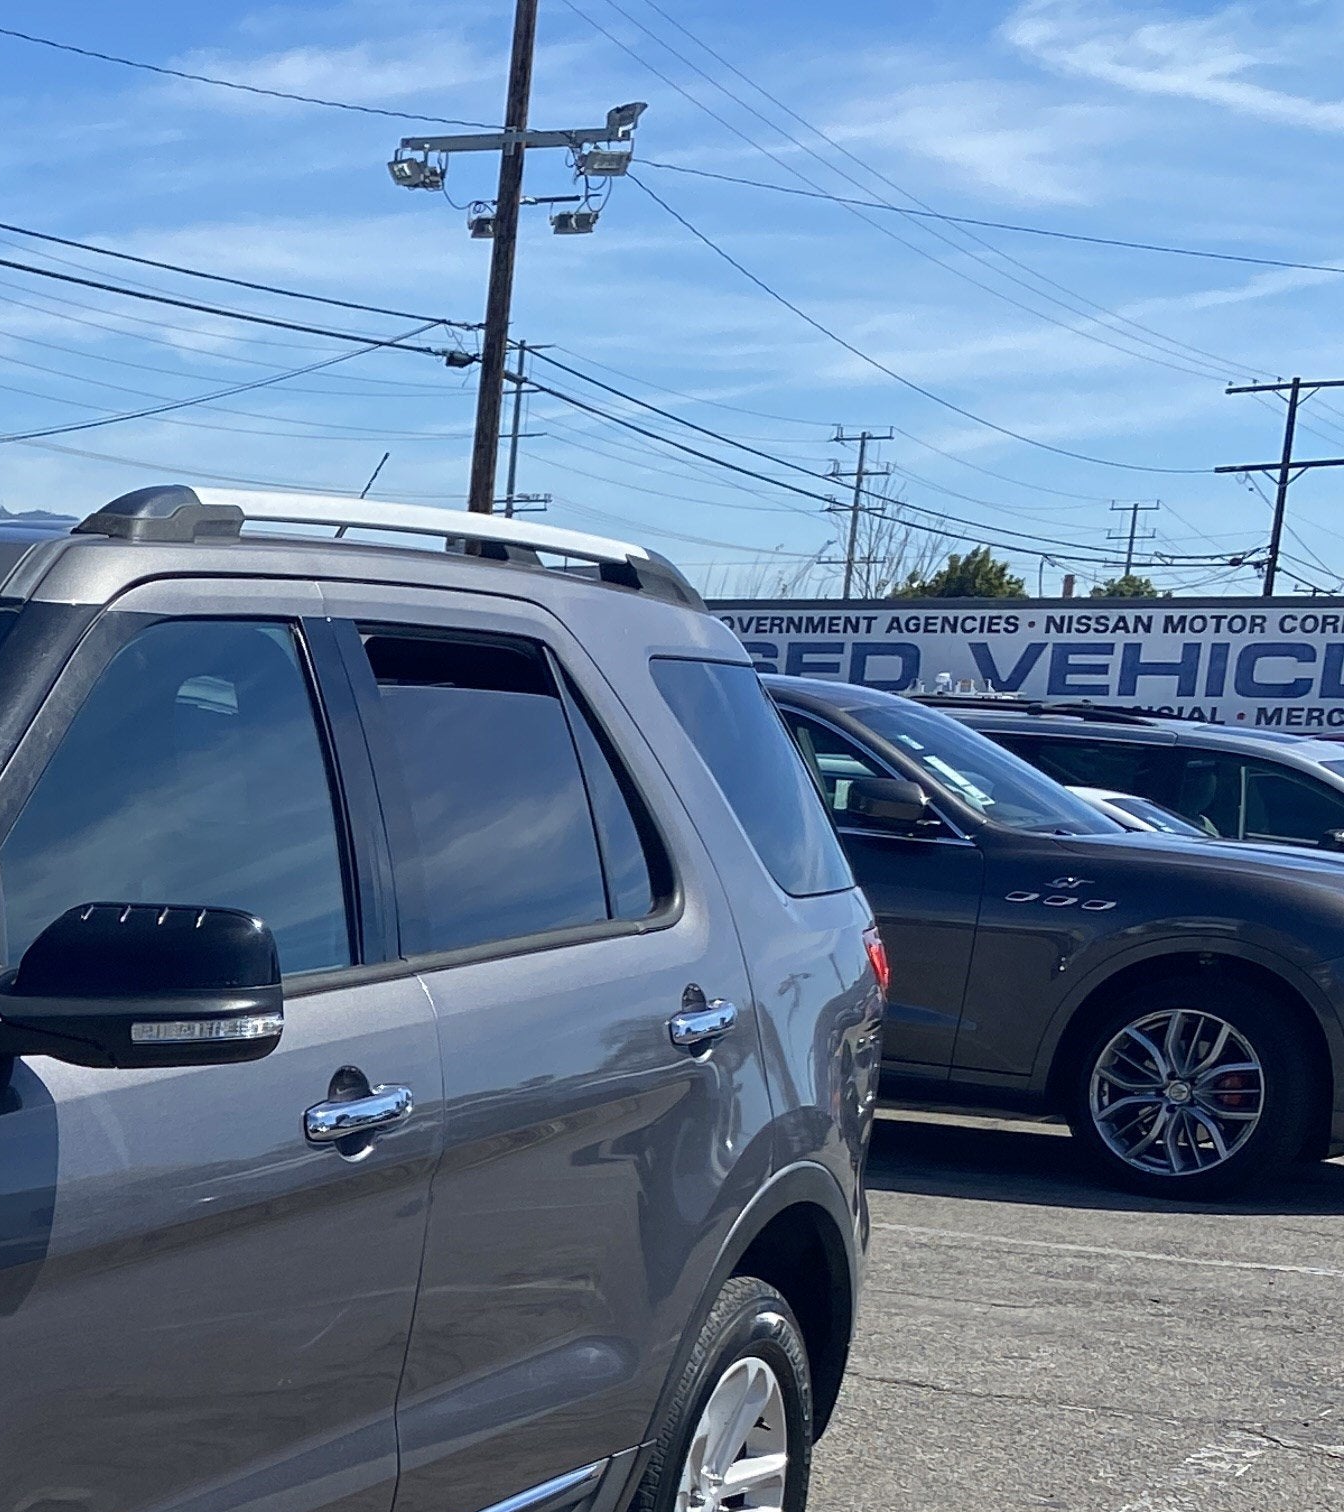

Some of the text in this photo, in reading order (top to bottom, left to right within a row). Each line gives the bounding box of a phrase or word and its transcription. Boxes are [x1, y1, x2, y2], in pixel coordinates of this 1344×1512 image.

[720, 614, 1344, 635] OVERNMENT AGENCIES NISSAN MOTOR COR
